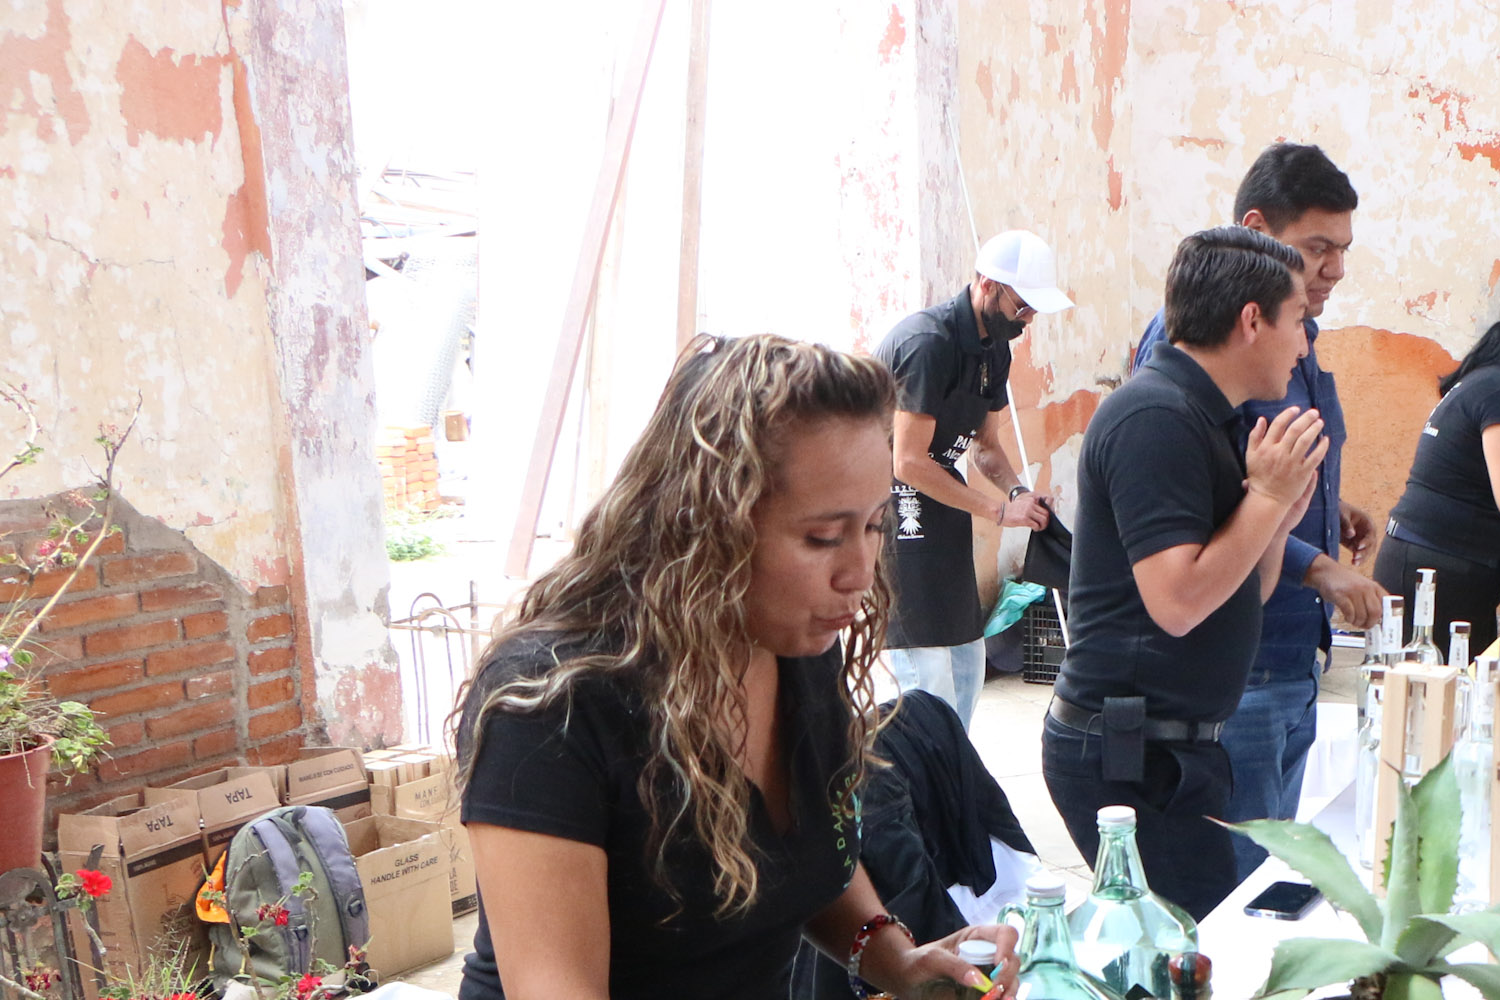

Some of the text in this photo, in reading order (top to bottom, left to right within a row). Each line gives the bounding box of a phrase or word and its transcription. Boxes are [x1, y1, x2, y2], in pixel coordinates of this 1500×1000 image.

[225, 787, 252, 804] TAPA
[145, 815, 174, 832] TAPA
[394, 853, 419, 867] GLASS
[370, 856, 438, 885] HANDLE WITH CARE
